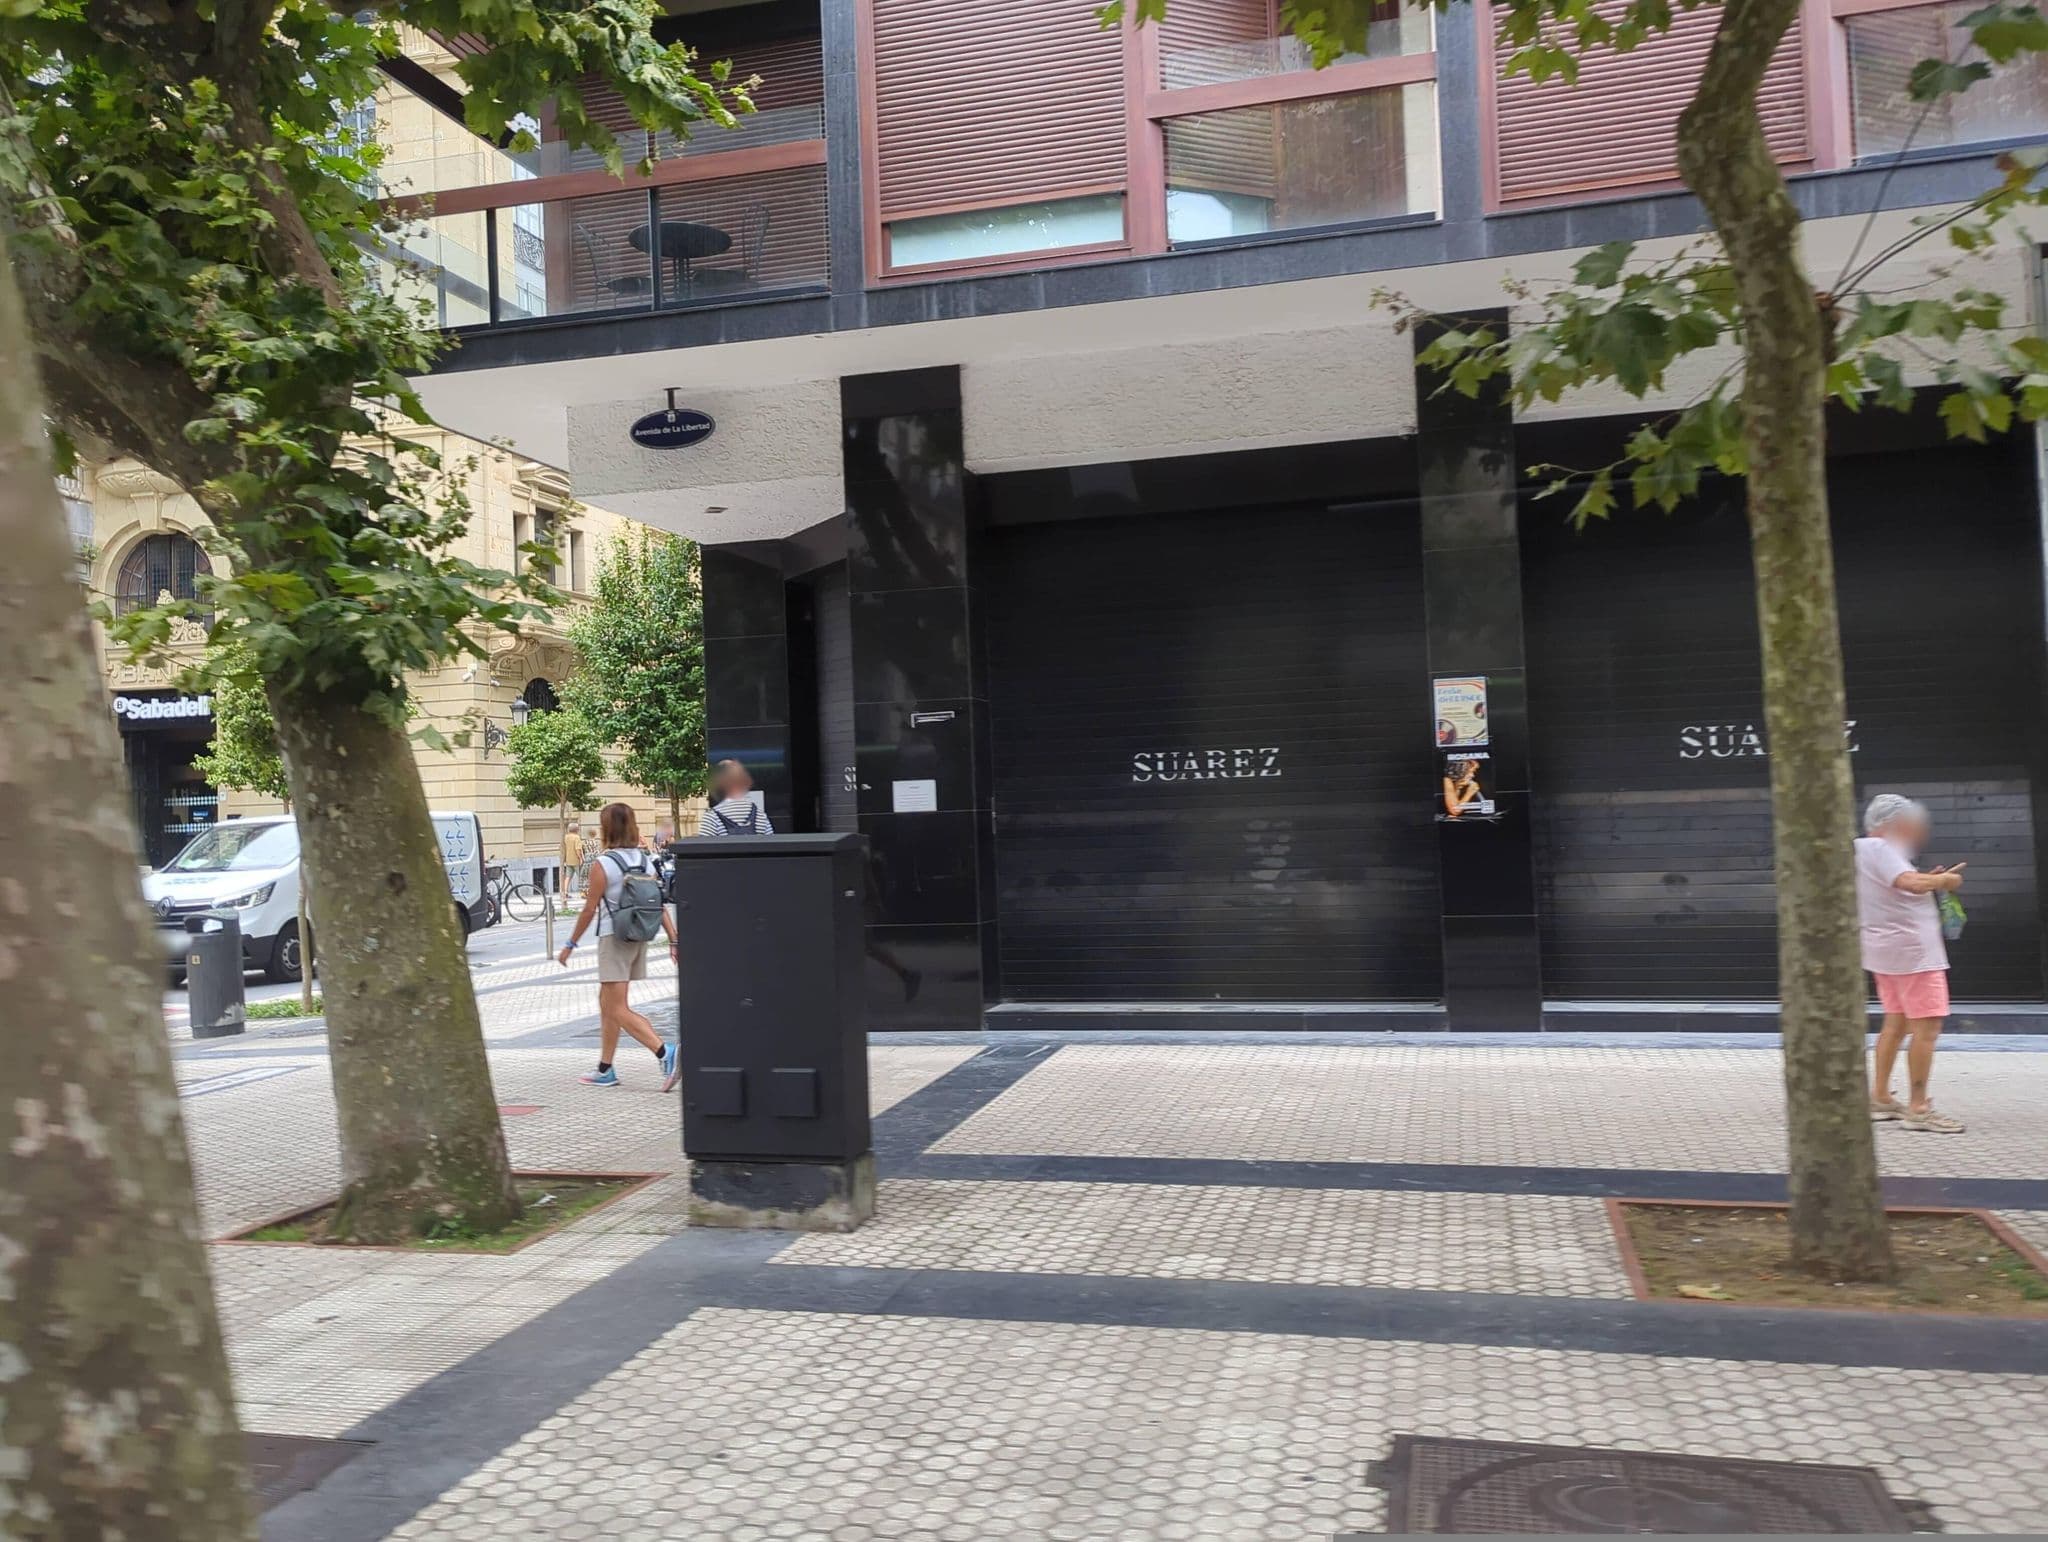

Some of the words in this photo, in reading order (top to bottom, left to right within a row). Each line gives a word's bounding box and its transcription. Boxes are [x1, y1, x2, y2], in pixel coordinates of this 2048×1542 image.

[635, 428, 661, 436] Avenida
[672, 425, 681, 433] La
[681, 422, 711, 432] Libertad
[126, 694, 212, 720] Sabadell
[1679, 723, 1860, 759] SUAZ
[1132, 747, 1282, 782] SUAREZ
